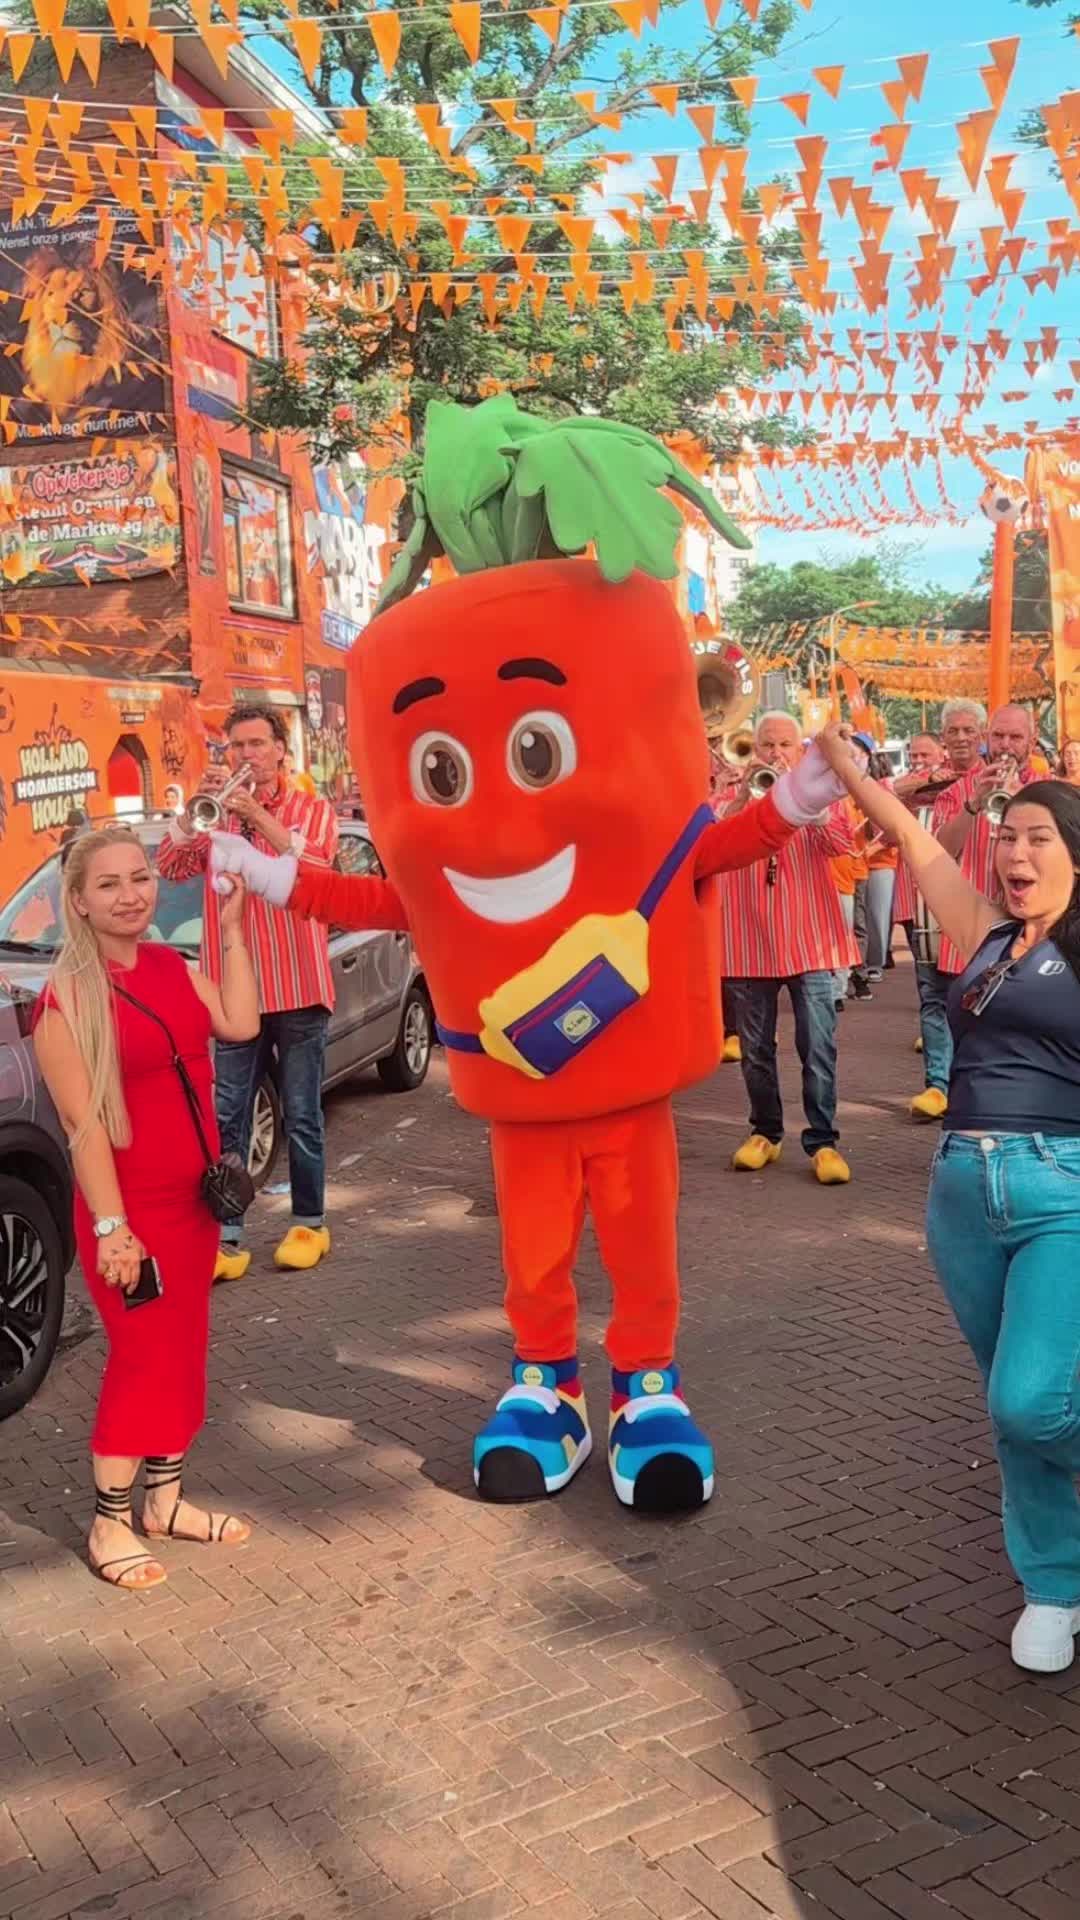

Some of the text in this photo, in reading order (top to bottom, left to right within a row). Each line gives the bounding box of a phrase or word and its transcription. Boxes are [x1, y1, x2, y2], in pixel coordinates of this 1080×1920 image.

[32, 233, 58, 245] onze
[28, 525, 49, 542] de
[20, 740, 89, 777] HOLLAND
[17, 771, 97, 799] HOMMERSON
